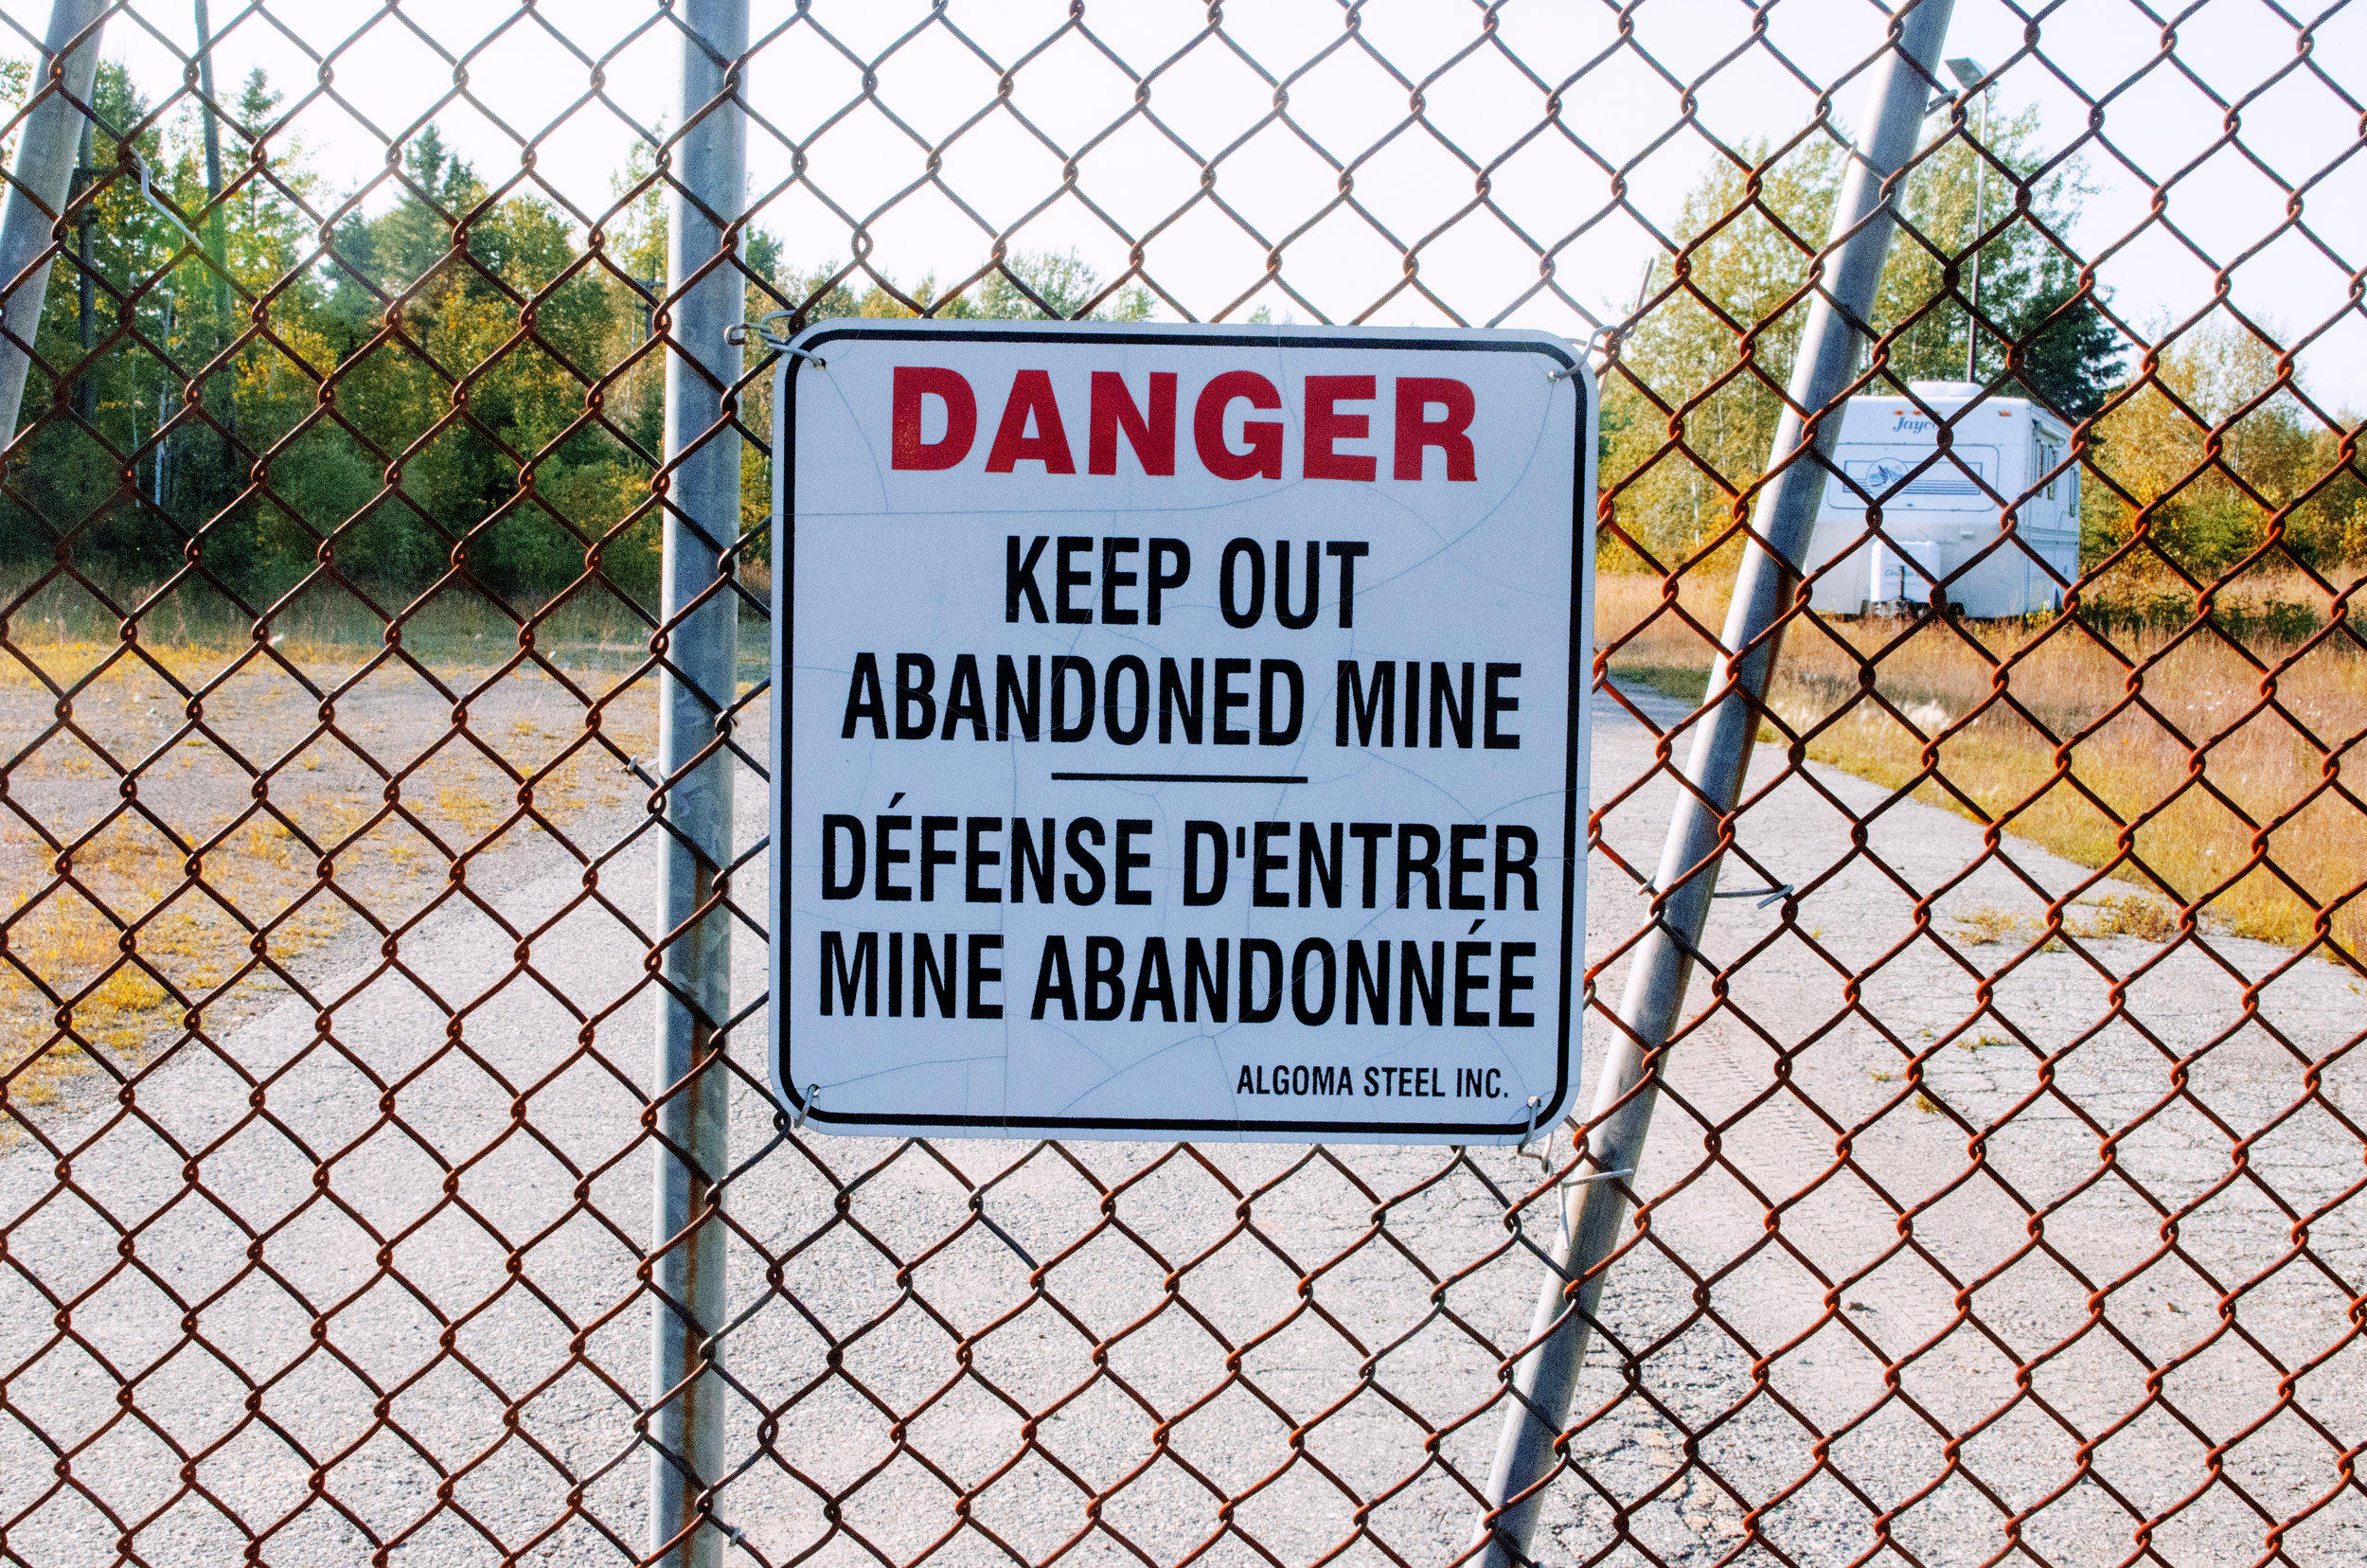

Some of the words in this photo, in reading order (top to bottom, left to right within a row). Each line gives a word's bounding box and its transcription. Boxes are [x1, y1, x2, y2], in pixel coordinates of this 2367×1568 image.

[892, 366, 1477, 481] DANGER
[1006, 536, 1190, 626] KEEP
[1219, 537, 1369, 630] OUT
[841, 652, 1304, 746] ABANDONED
[1336, 660, 1522, 749] MINE
[822, 793, 1152, 906] DÉFENSE
[1184, 820, 1539, 911] D'ENTRER
[820, 931, 1004, 1019] MINE
[1030, 918, 1536, 1027] ABANDONNÉE
[1237, 1065, 1353, 1096] ALGOMA
[1364, 1066, 1445, 1096] STEEL
[1457, 1068, 1509, 1098] INC.
